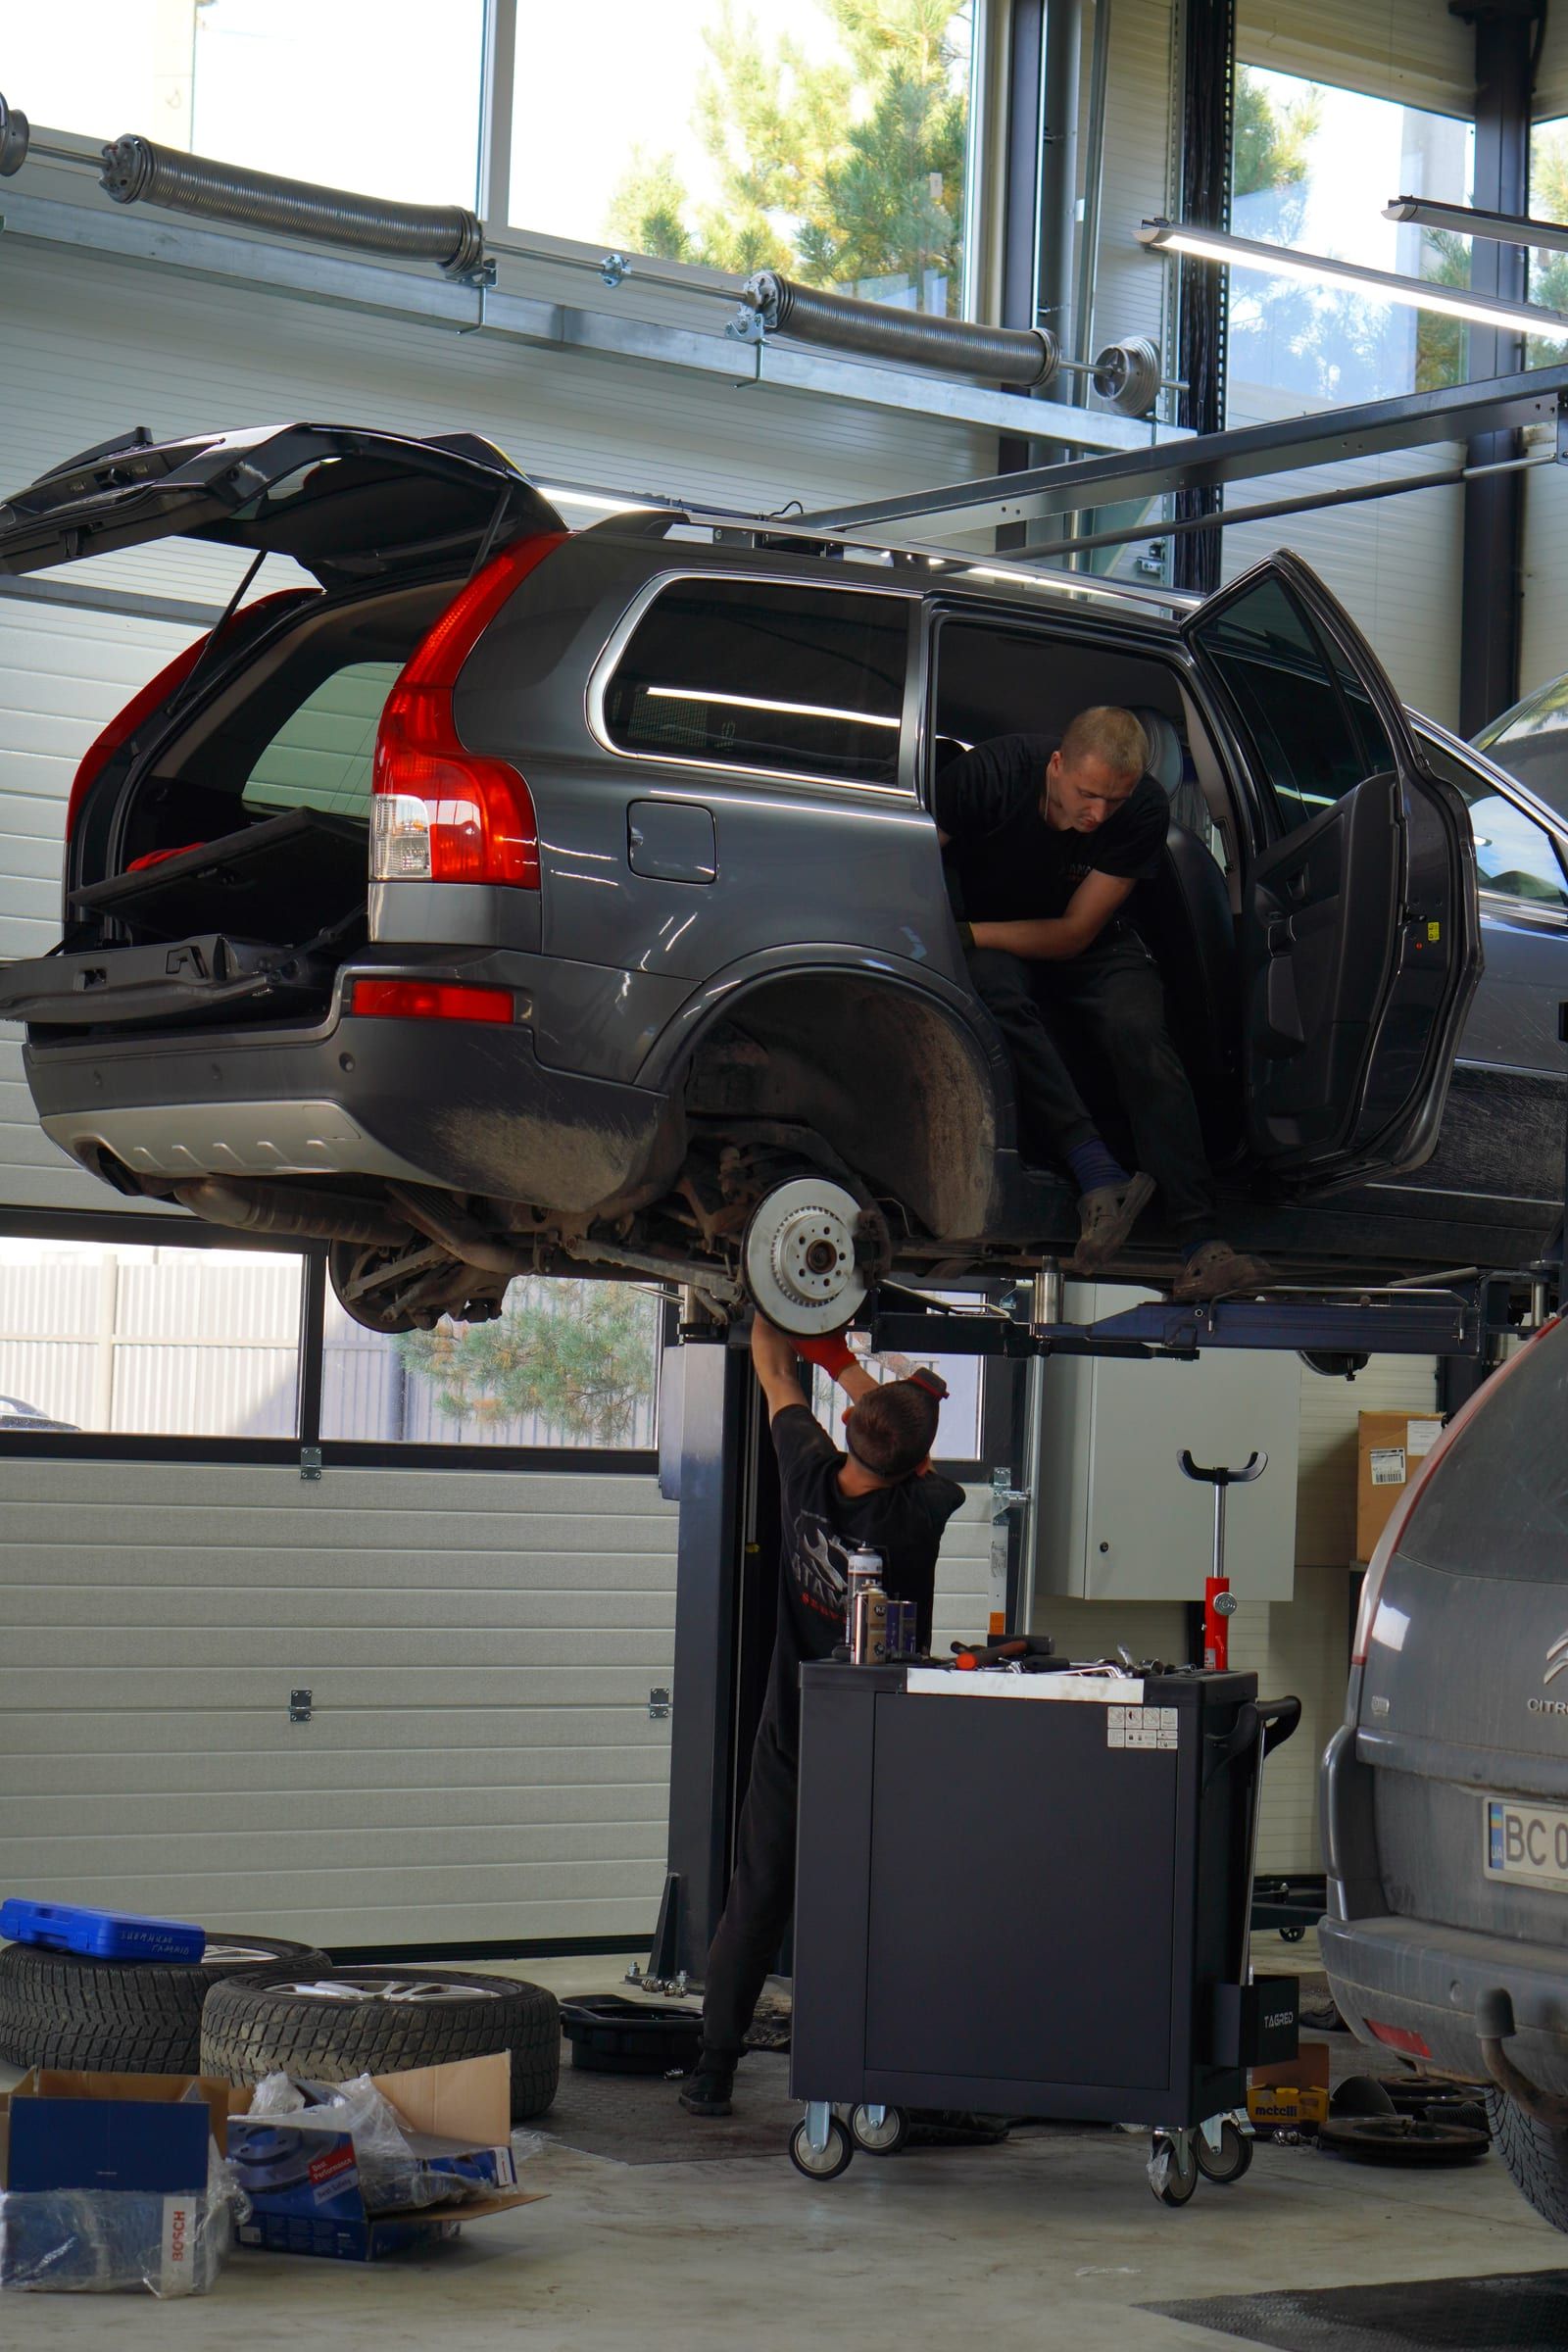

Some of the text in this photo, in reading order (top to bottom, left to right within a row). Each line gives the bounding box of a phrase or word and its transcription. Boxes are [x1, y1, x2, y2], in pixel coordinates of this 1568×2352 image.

[1527, 1697, 1568, 1715] CITR
[1491, 1844, 1503, 1859] UA
[1264, 2011, 1294, 2029] TAGRED
[1254, 2105, 1298, 2117] metelli
[313, 2157, 353, 2180] Performance
[172, 2210, 185, 2262] BOSCH
